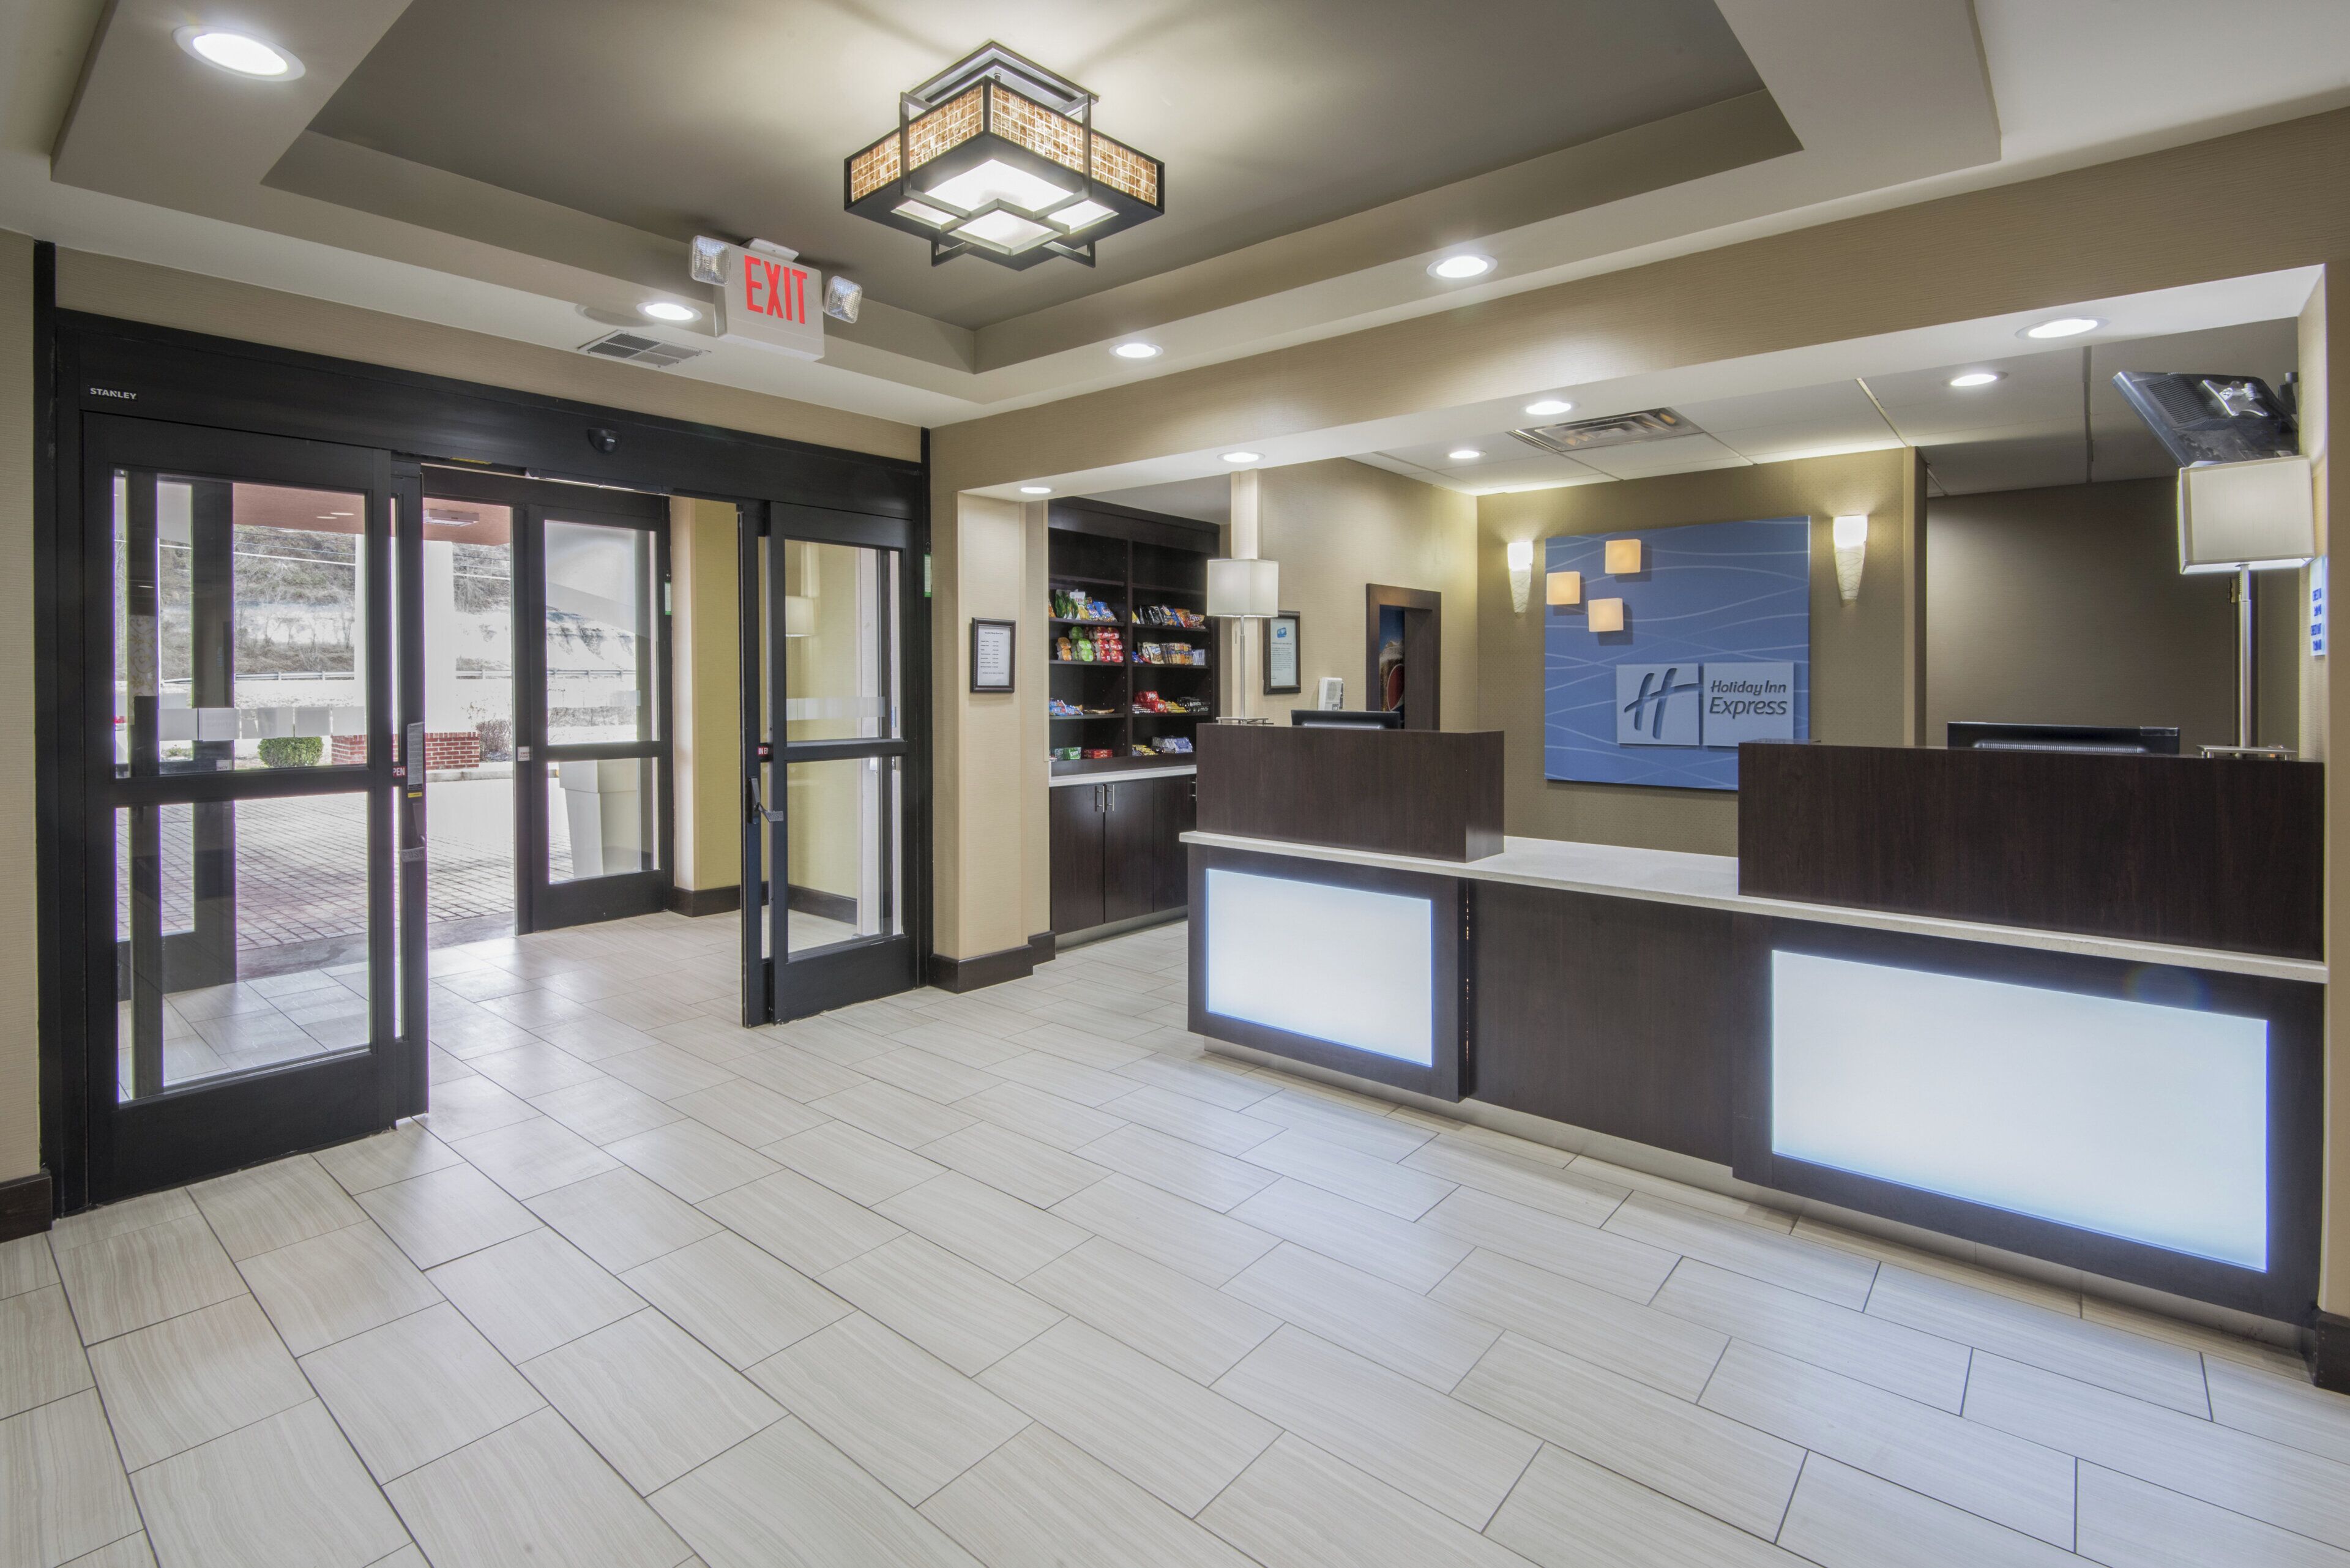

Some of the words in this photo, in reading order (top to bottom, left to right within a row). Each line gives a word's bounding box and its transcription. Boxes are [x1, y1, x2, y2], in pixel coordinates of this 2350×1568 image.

[744, 255, 808, 325] EXIT
[89, 387, 137, 400] STANLEY
[1710, 679, 1763, 696] Holiday
[1764, 680, 1786, 693] Inn
[1709, 696, 1788, 719] Express
[393, 767, 405, 776] PEN
